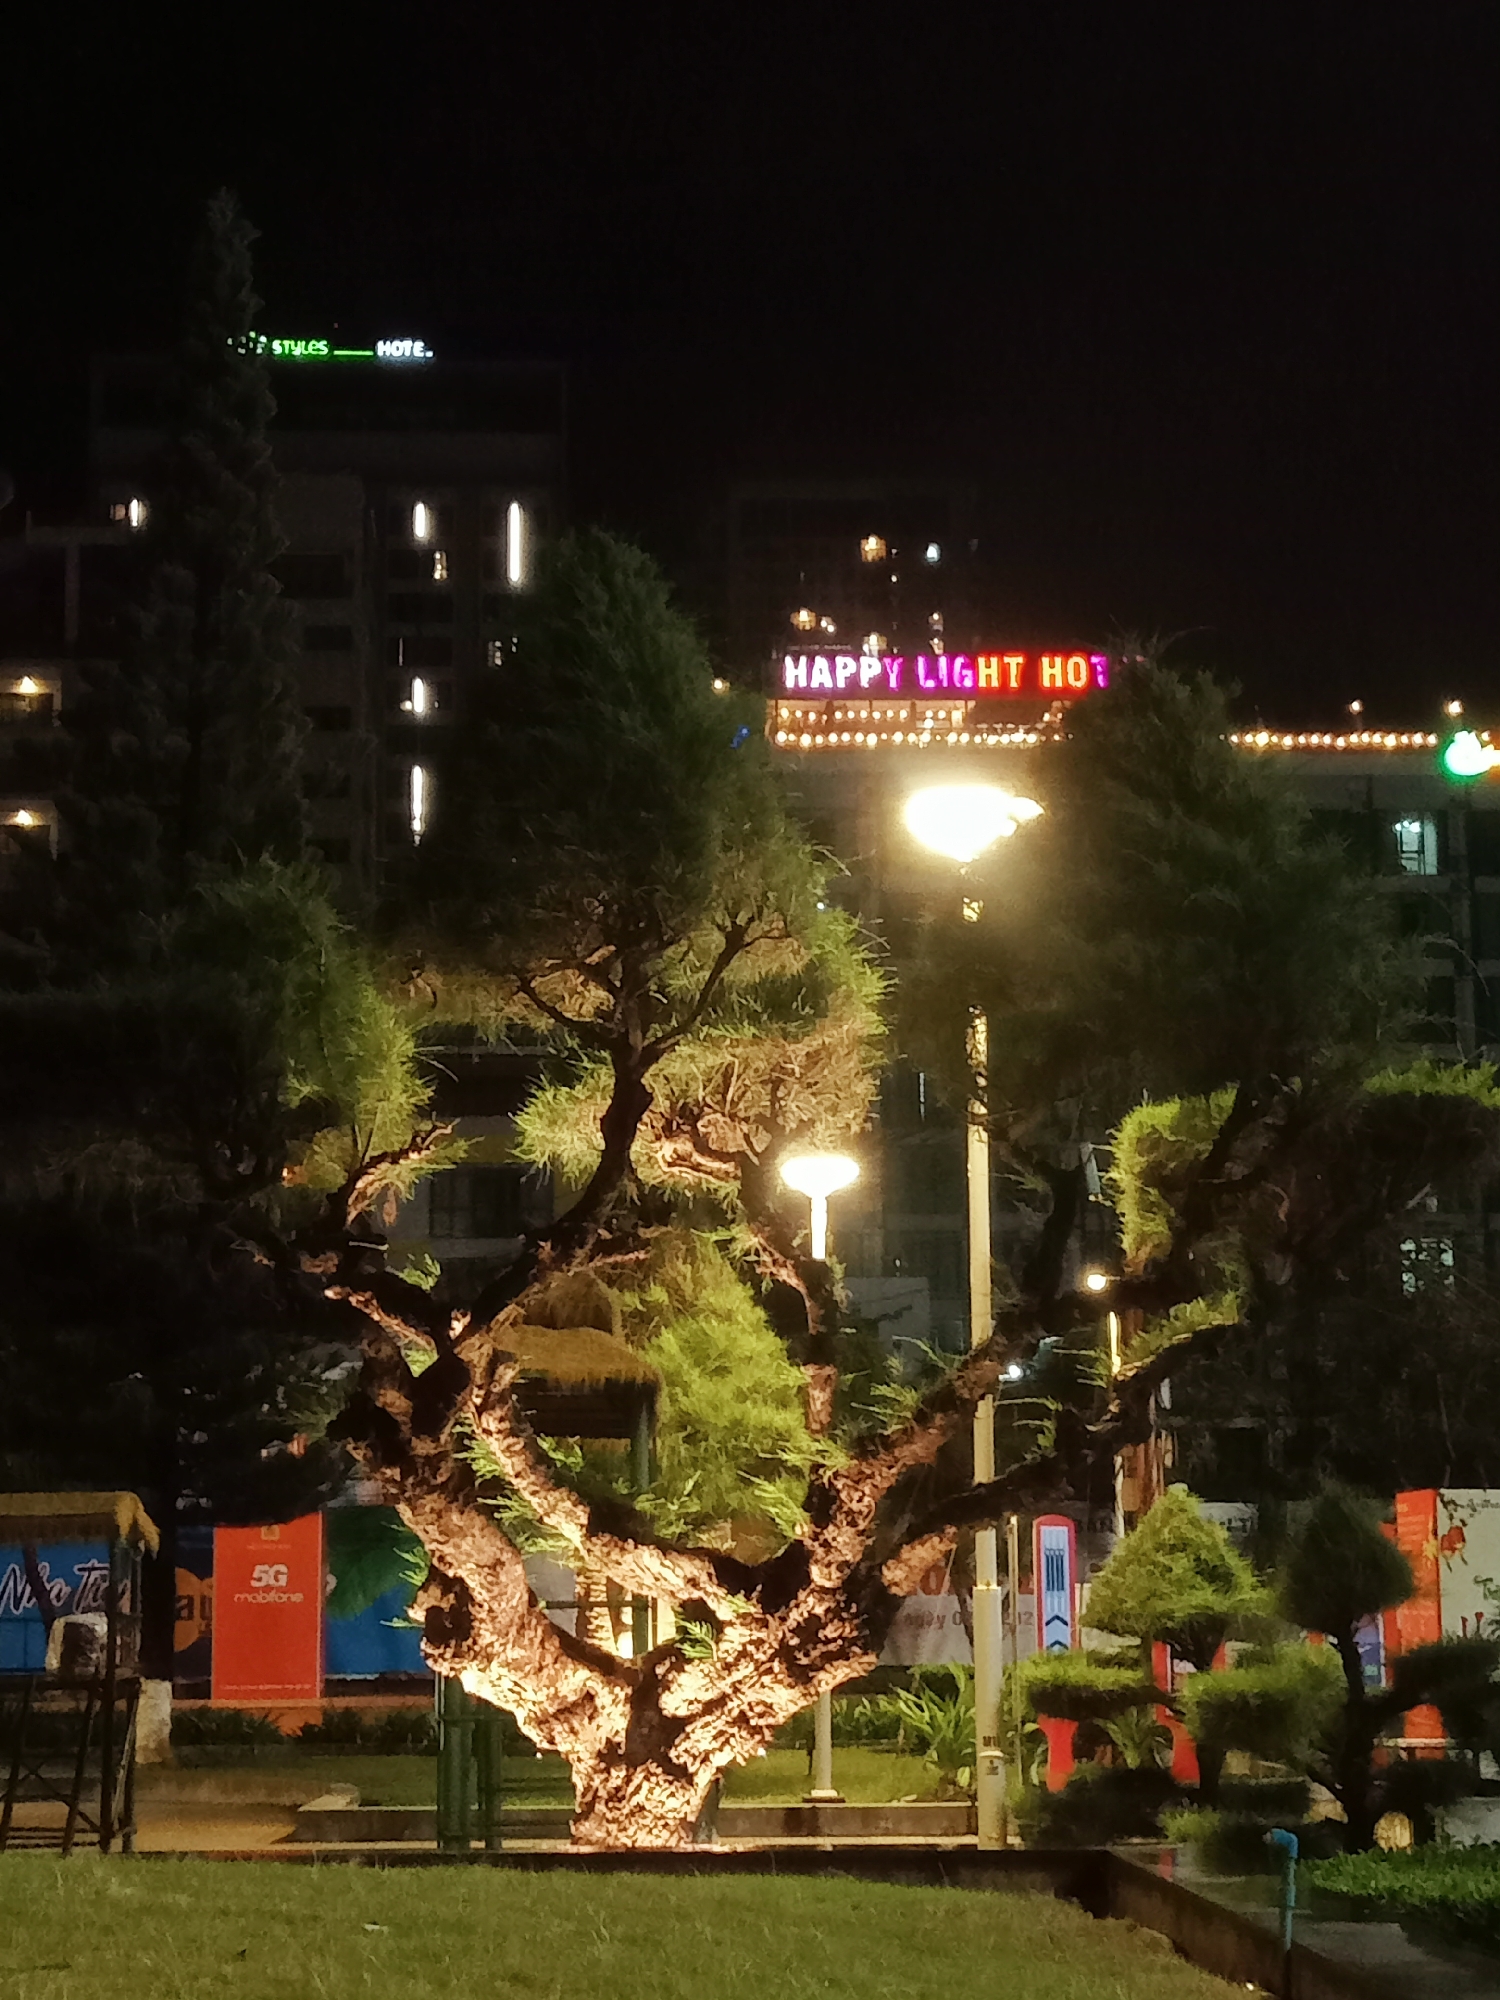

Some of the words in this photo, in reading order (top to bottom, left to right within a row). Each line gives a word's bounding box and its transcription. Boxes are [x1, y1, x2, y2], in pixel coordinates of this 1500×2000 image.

[784, 655, 904, 689] HAPPY
[917, 655, 1023, 689] LIGHT
[251, 1564, 289, 1588] 5G
